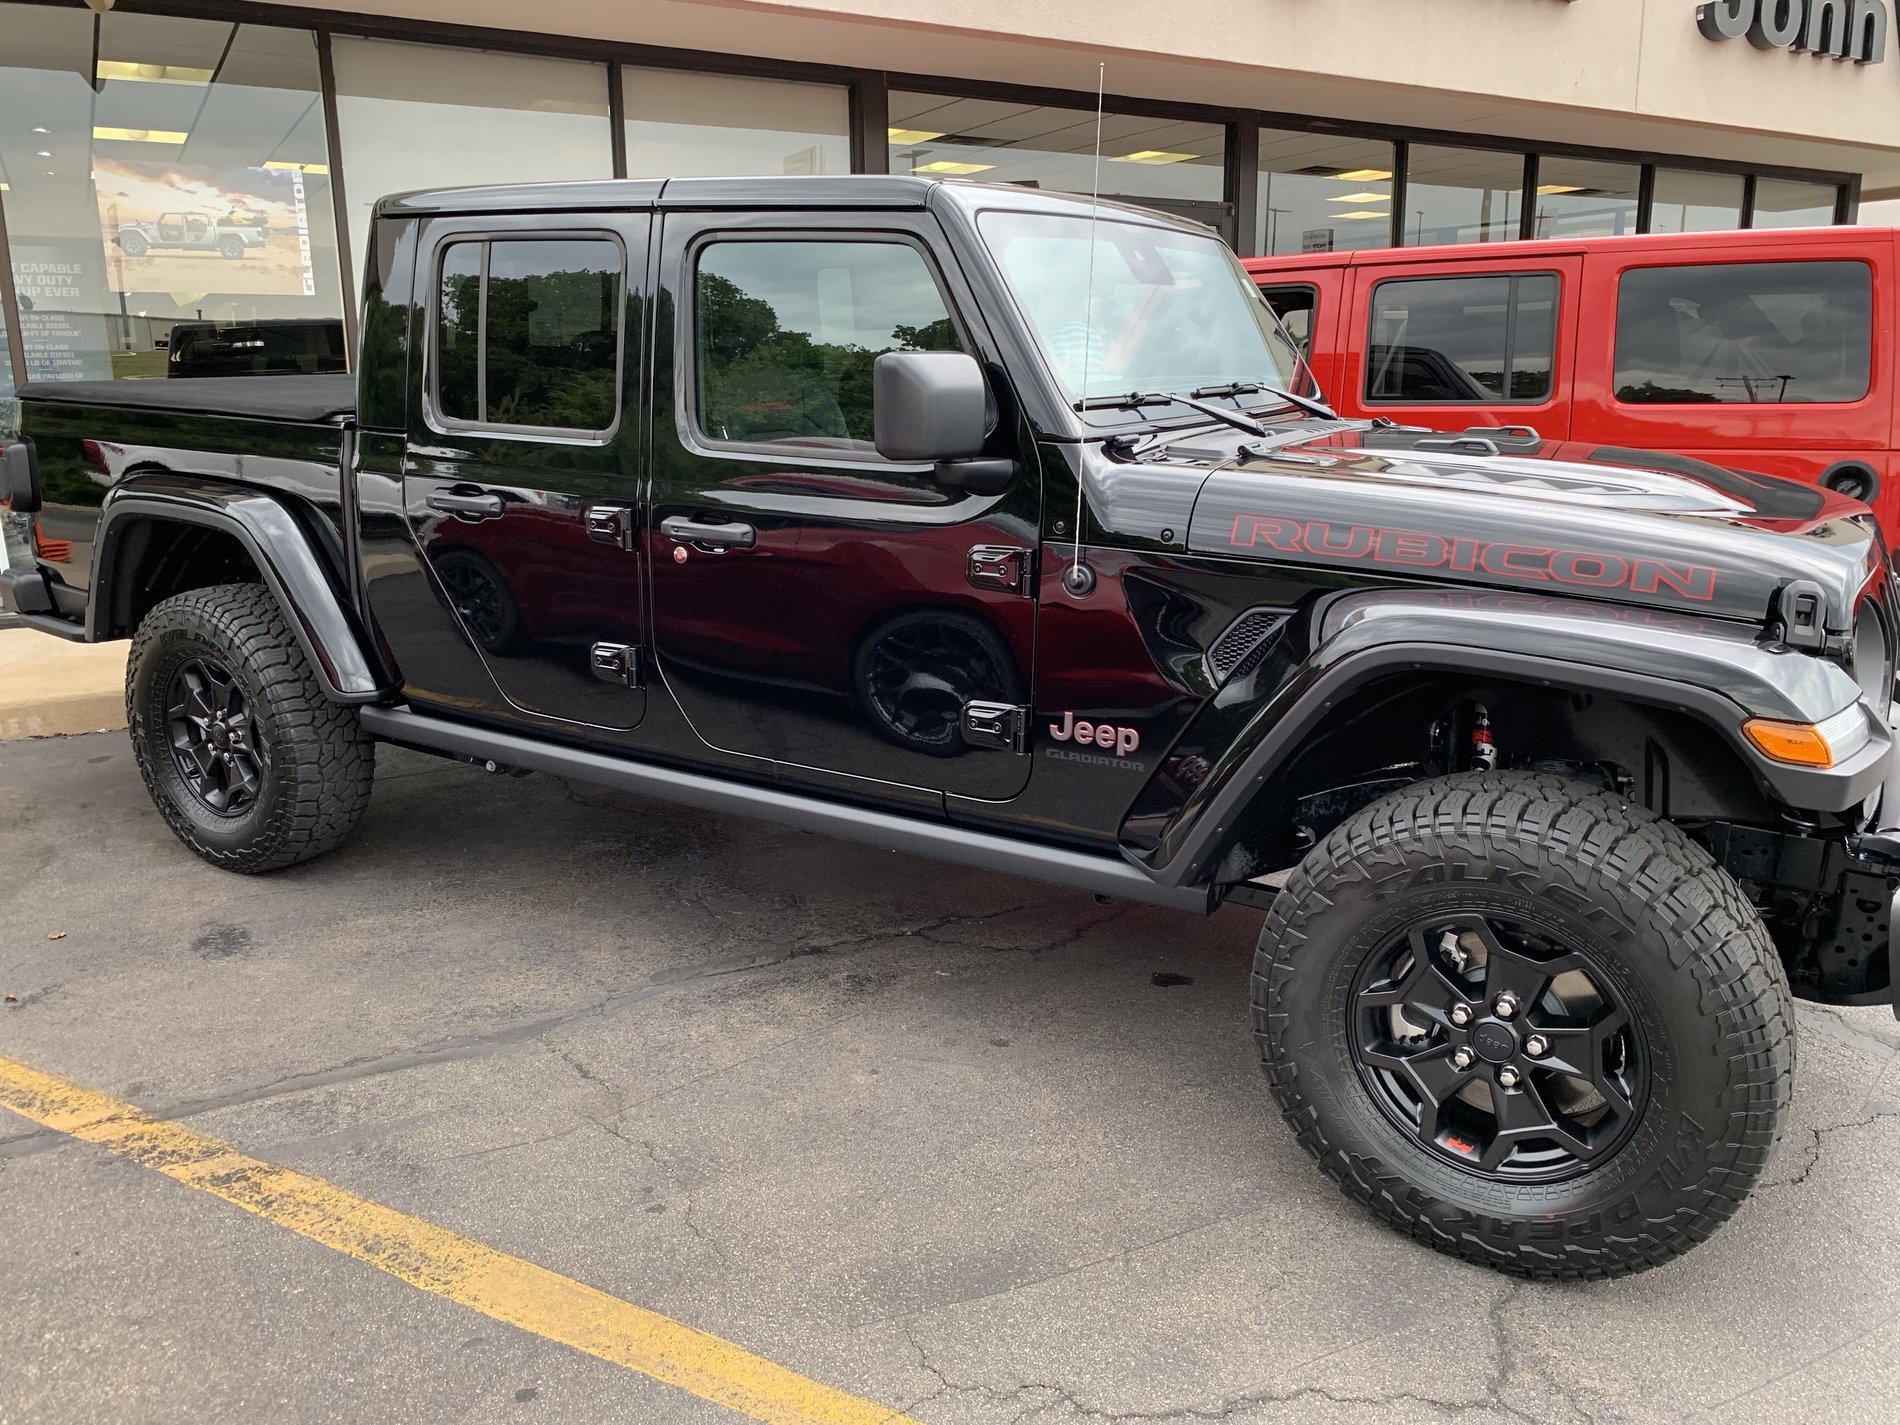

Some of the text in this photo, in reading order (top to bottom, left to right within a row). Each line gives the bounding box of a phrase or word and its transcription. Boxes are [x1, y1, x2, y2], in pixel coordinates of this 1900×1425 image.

[293, 171, 316, 297] GLADIATOR
[20, 263, 82, 274] CAPABLE
[36, 275, 73, 286] DUTY
[44, 286, 81, 297] EVER
[1230, 513, 1718, 601] RUBICON
[1049, 711, 1140, 757] Jeep
[1045, 747, 1145, 772] GLADIATOR
